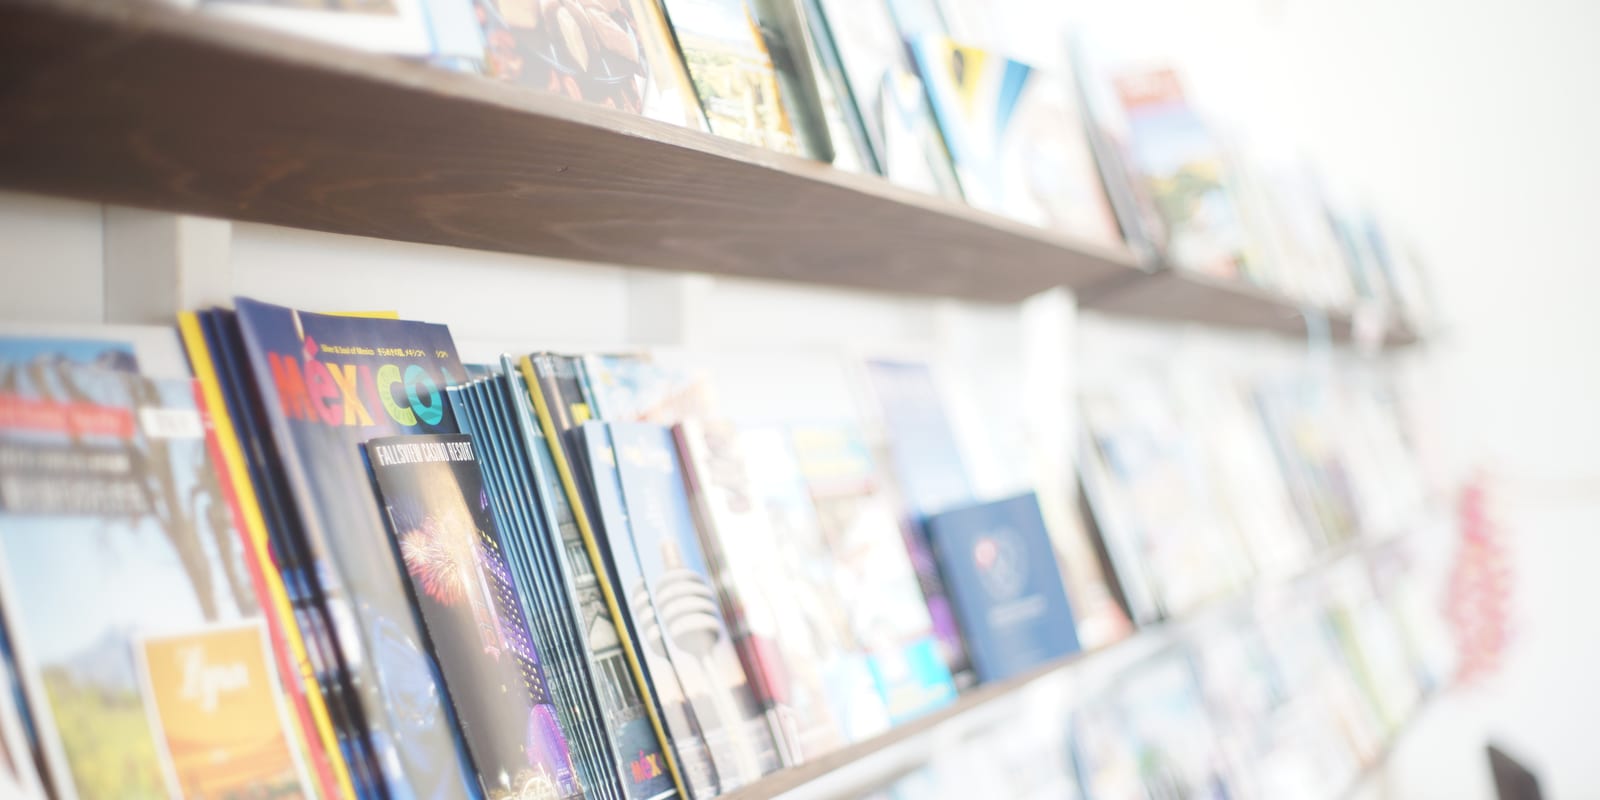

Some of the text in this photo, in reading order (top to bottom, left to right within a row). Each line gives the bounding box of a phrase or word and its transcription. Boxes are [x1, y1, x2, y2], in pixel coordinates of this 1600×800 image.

[375, 441, 475, 466] FALLSVIEW CASINO RESORT
